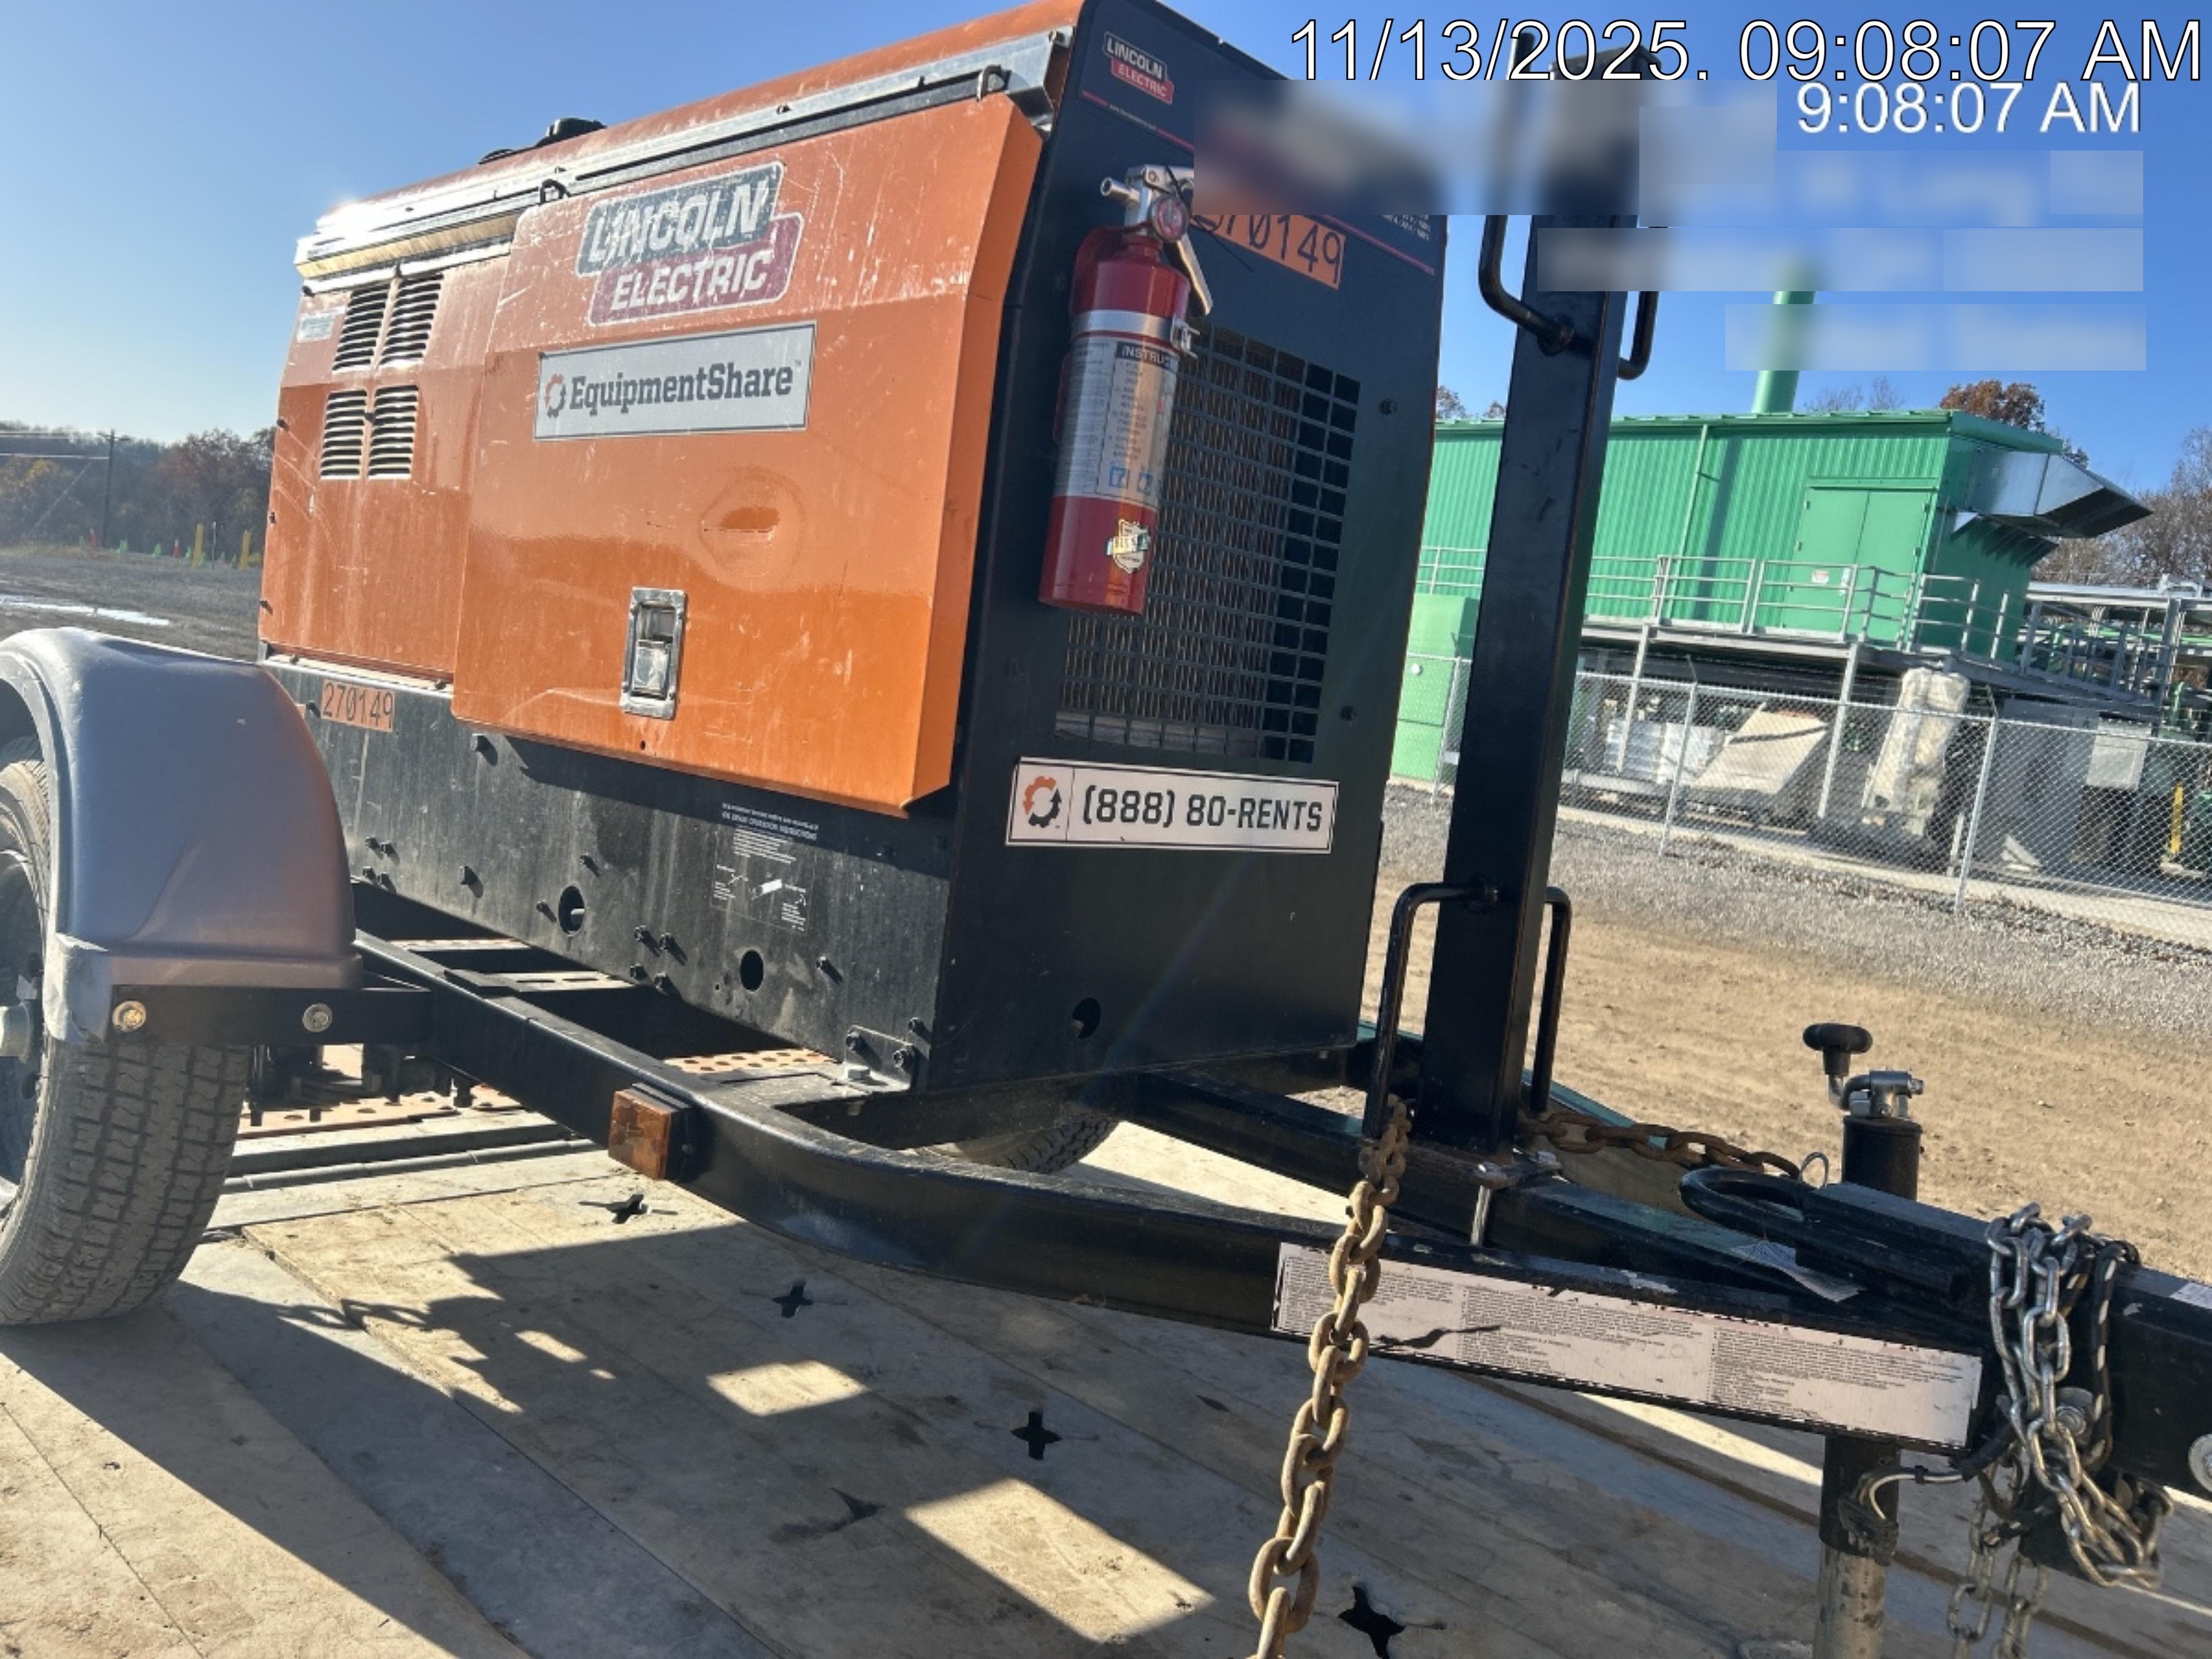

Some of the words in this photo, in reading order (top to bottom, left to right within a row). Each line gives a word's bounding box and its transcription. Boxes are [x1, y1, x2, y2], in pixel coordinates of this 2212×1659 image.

[1107, 37, 1163, 80] LINCOLN
[1118, 64, 1167, 98] ELECTRIC
[587, 179, 770, 263] LINCOLN
[610, 248, 774, 310] ELECTRIC
[569, 362, 793, 414] EquipmentShare
[323, 682, 393, 729] 270149
[1083, 785, 1175, 828] (888)
[1186, 794, 1322, 831] 80-RENTS
